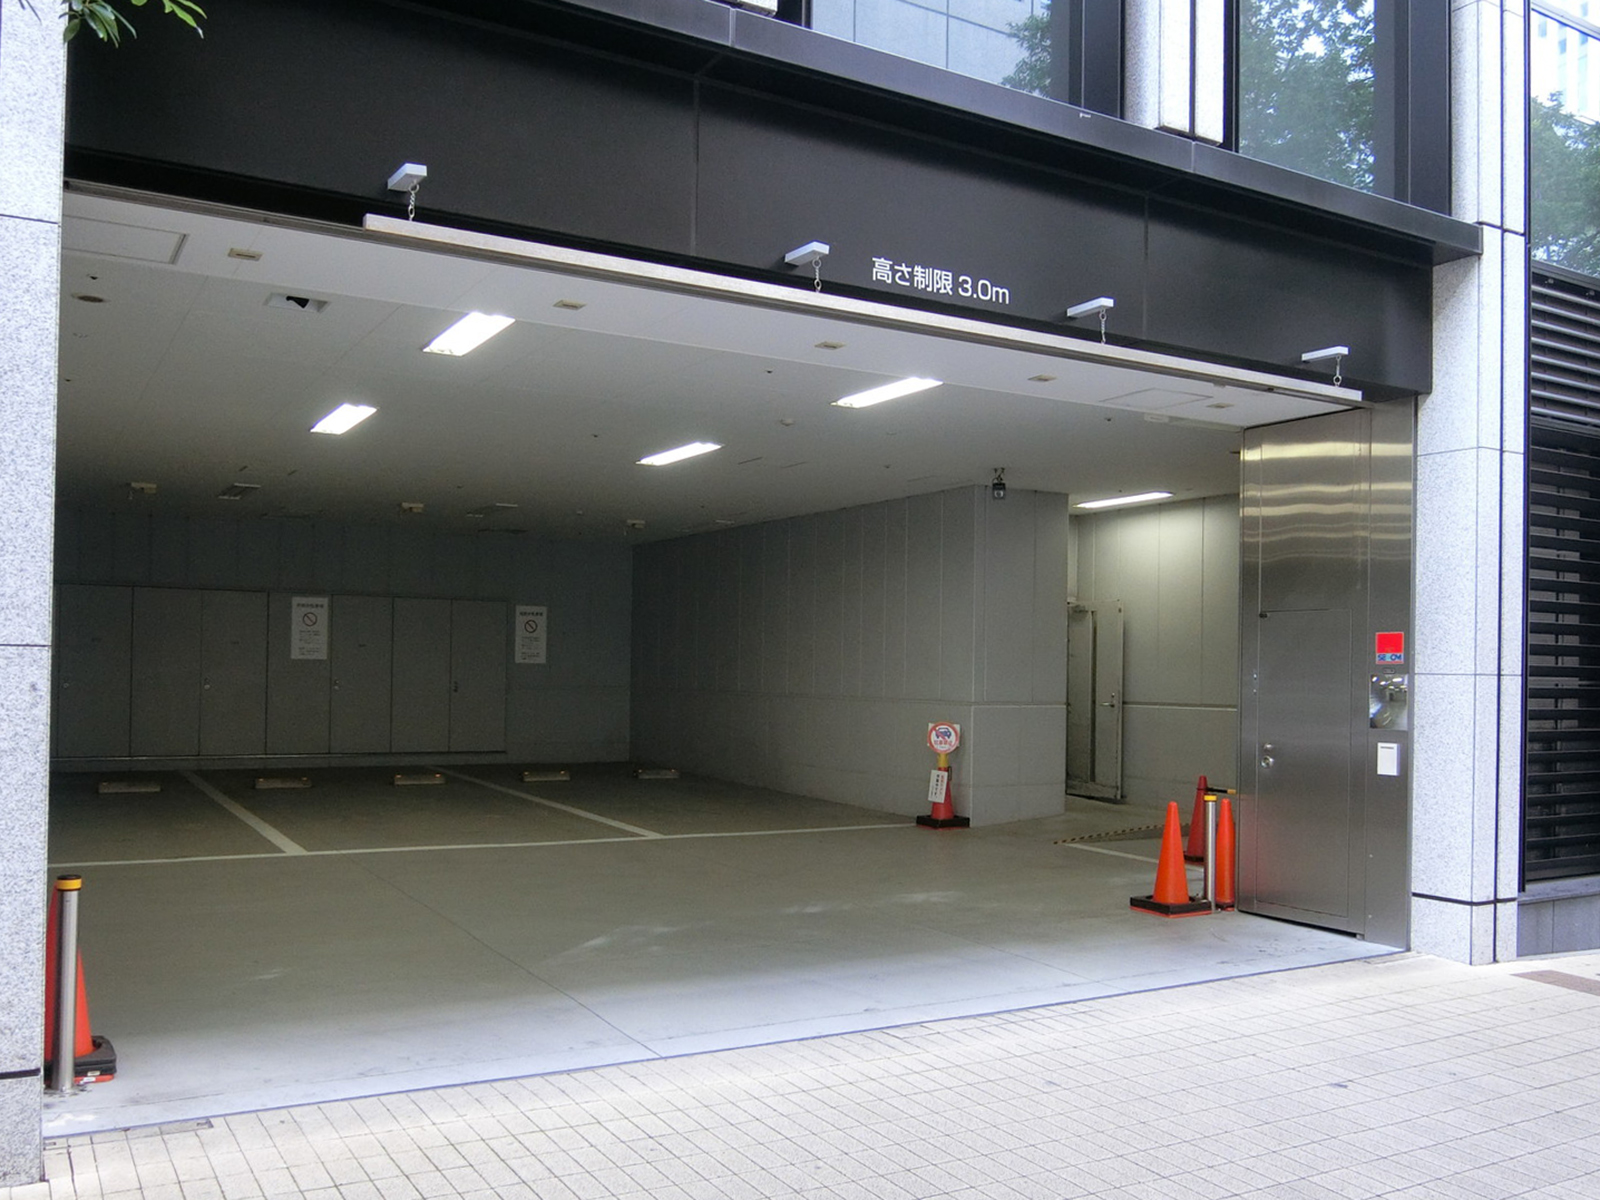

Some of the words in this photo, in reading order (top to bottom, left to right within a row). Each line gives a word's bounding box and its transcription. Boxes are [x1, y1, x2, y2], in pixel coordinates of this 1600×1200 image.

[872, 257, 953, 295] 高さ制限
[958, 275, 1009, 304] 3.0m
